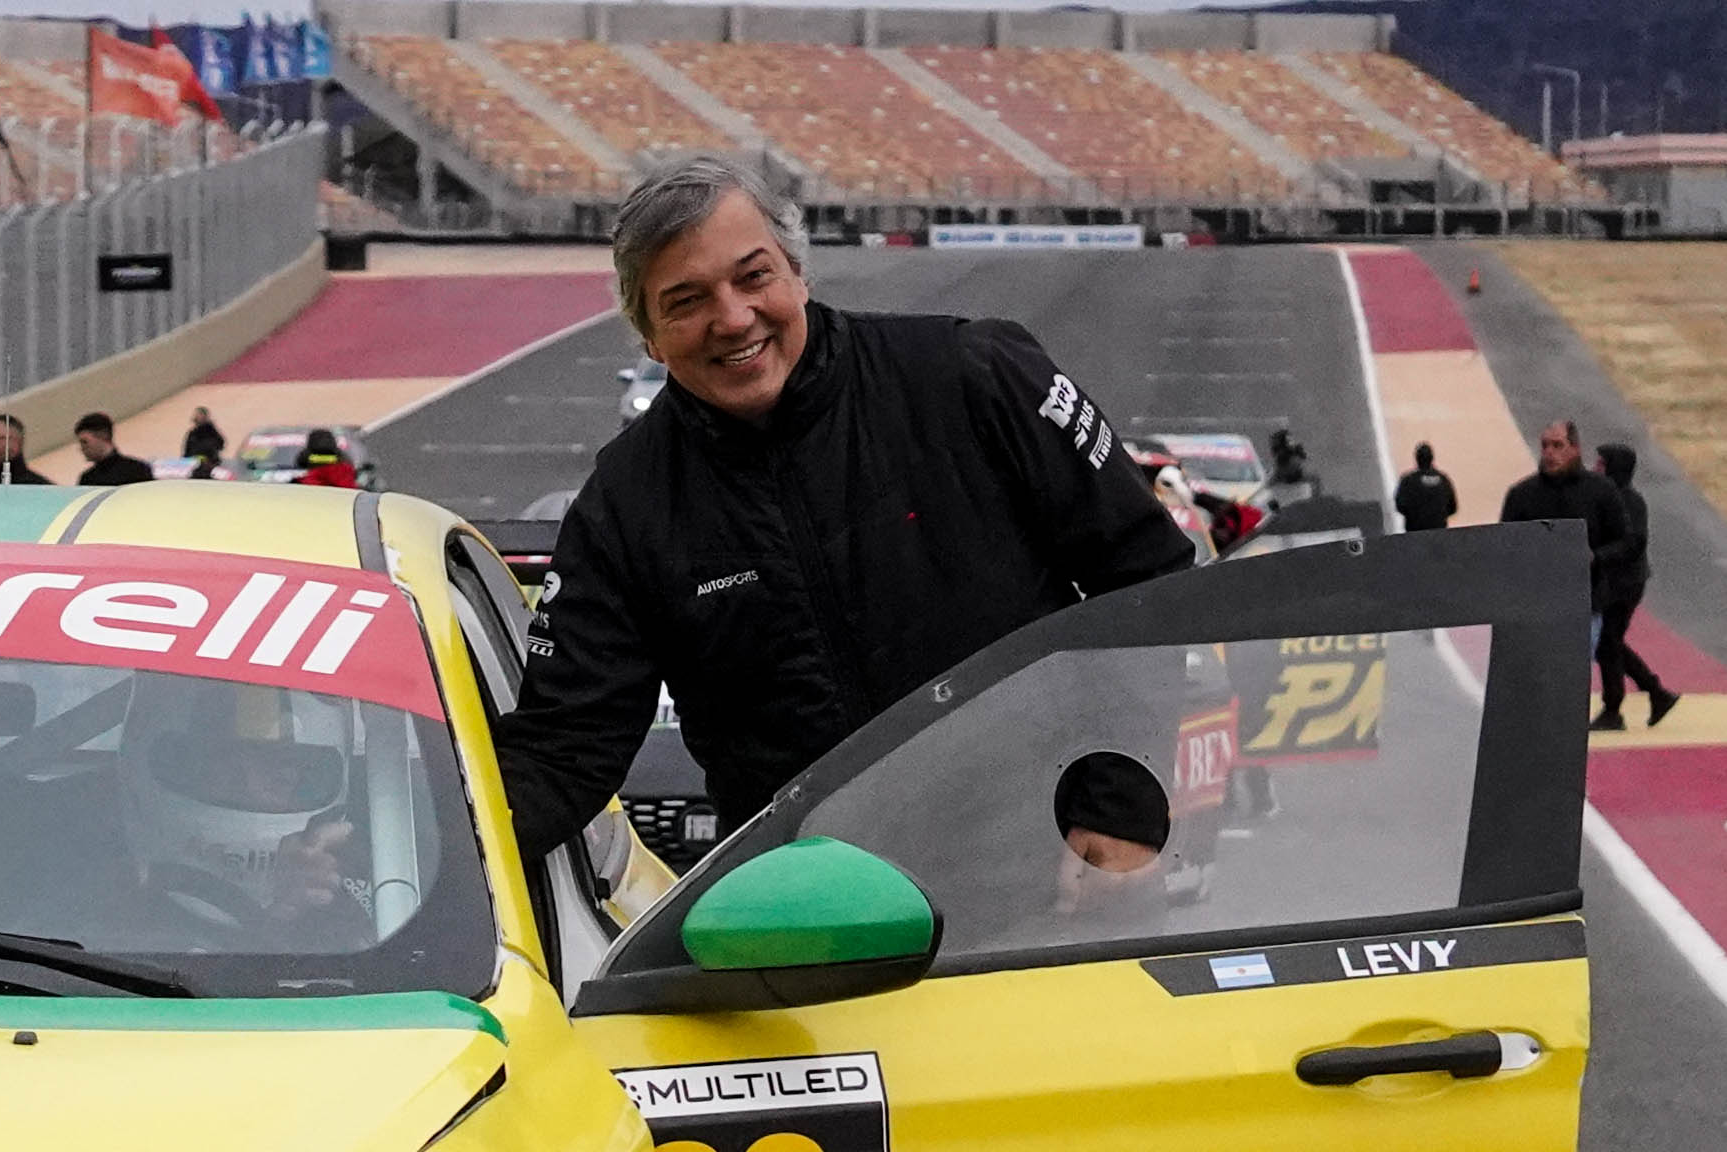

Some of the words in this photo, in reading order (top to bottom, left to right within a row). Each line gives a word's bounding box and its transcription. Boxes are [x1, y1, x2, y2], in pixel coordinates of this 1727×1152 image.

[696, 570, 760, 597] AUTOSPORTS
[1337, 939, 1457, 978] LEVY
[646, 1066, 869, 1106] MULTILED
